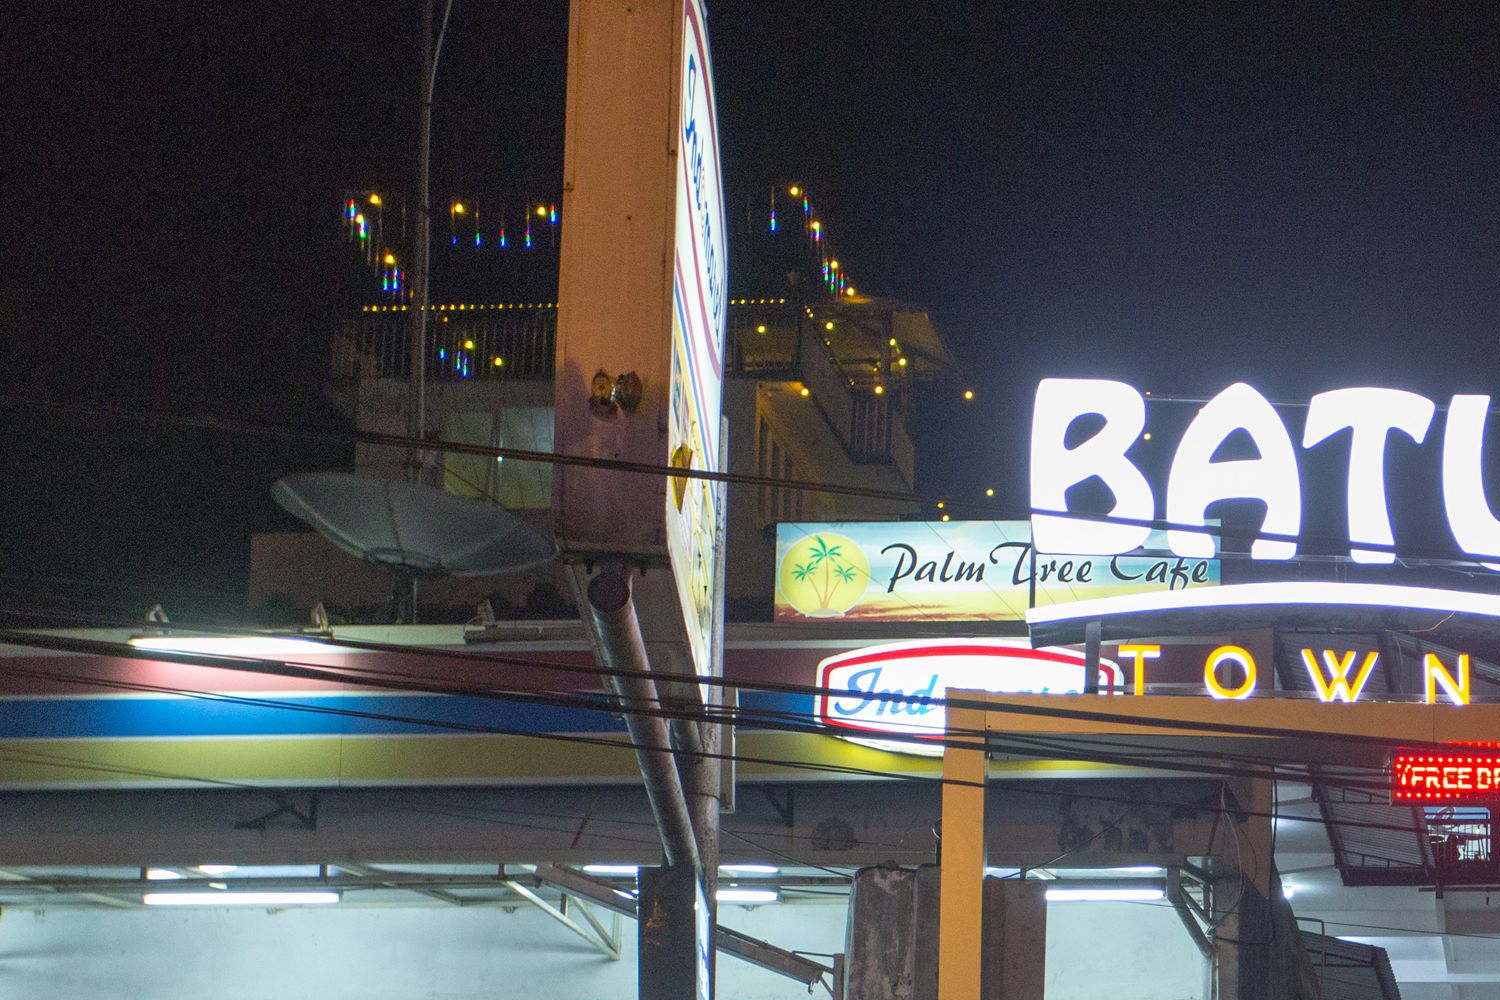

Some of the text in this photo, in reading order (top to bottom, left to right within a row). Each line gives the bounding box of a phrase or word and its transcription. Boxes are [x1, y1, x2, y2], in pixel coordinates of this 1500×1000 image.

[881, 543, 985, 593] Palm
[989, 542, 1092, 586] Tree
[1118, 644, 1471, 706] TOWN
